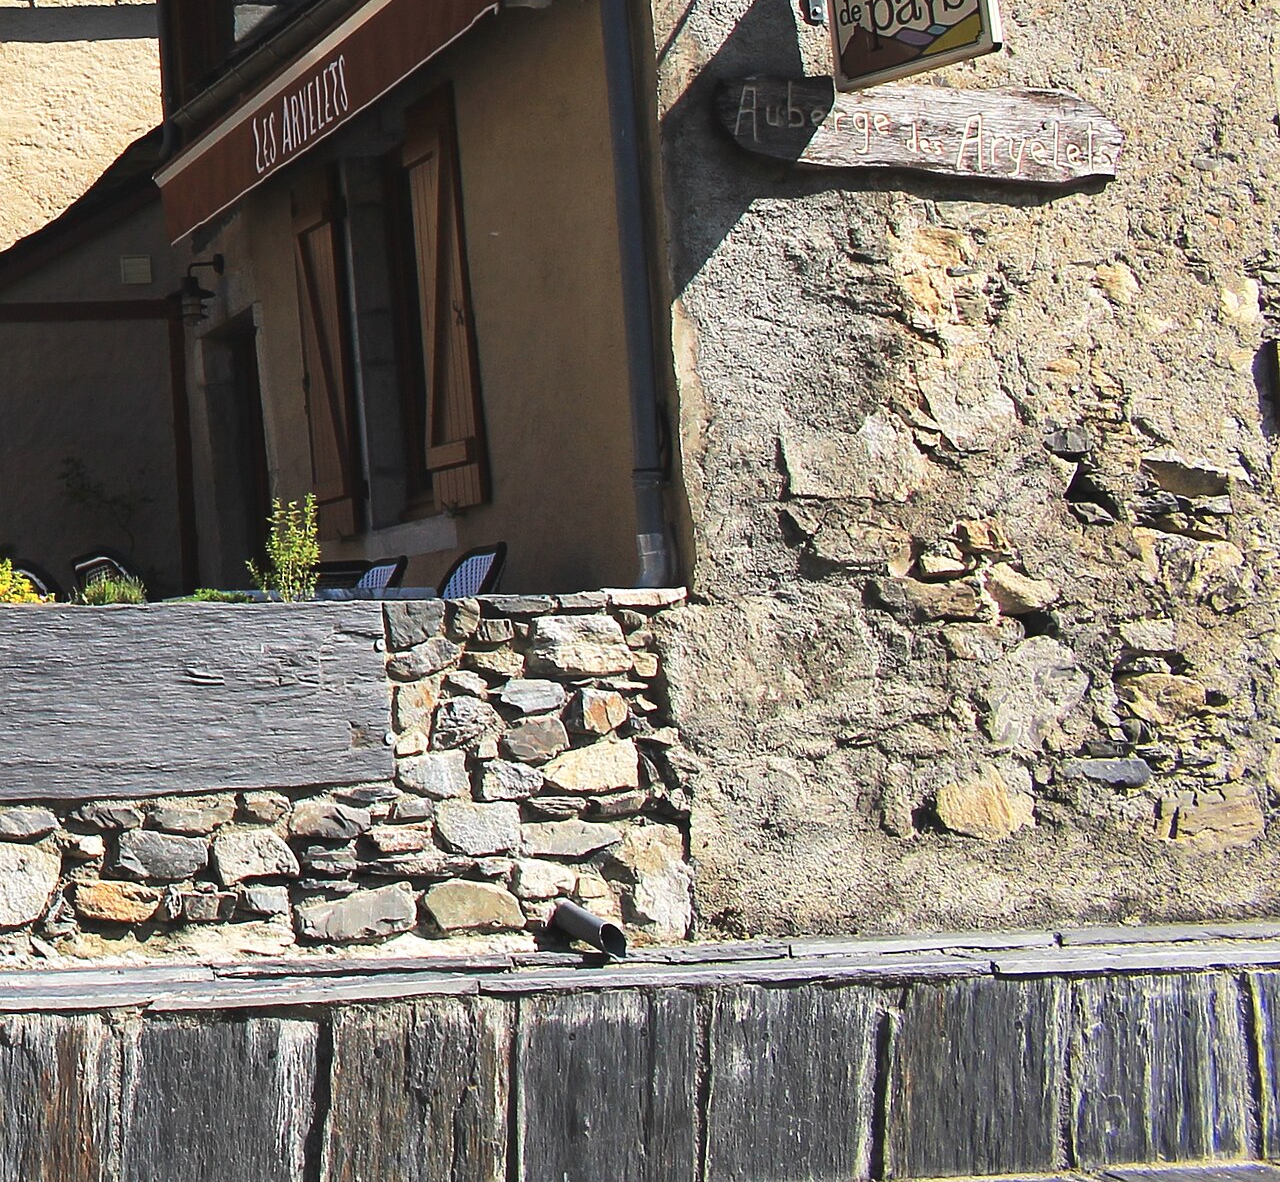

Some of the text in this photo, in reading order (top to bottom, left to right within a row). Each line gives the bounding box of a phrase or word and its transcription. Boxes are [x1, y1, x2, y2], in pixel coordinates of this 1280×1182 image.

[282, 54, 349, 155] ARYELETS
[734, 81, 1115, 177] Auberge des Aryelets
